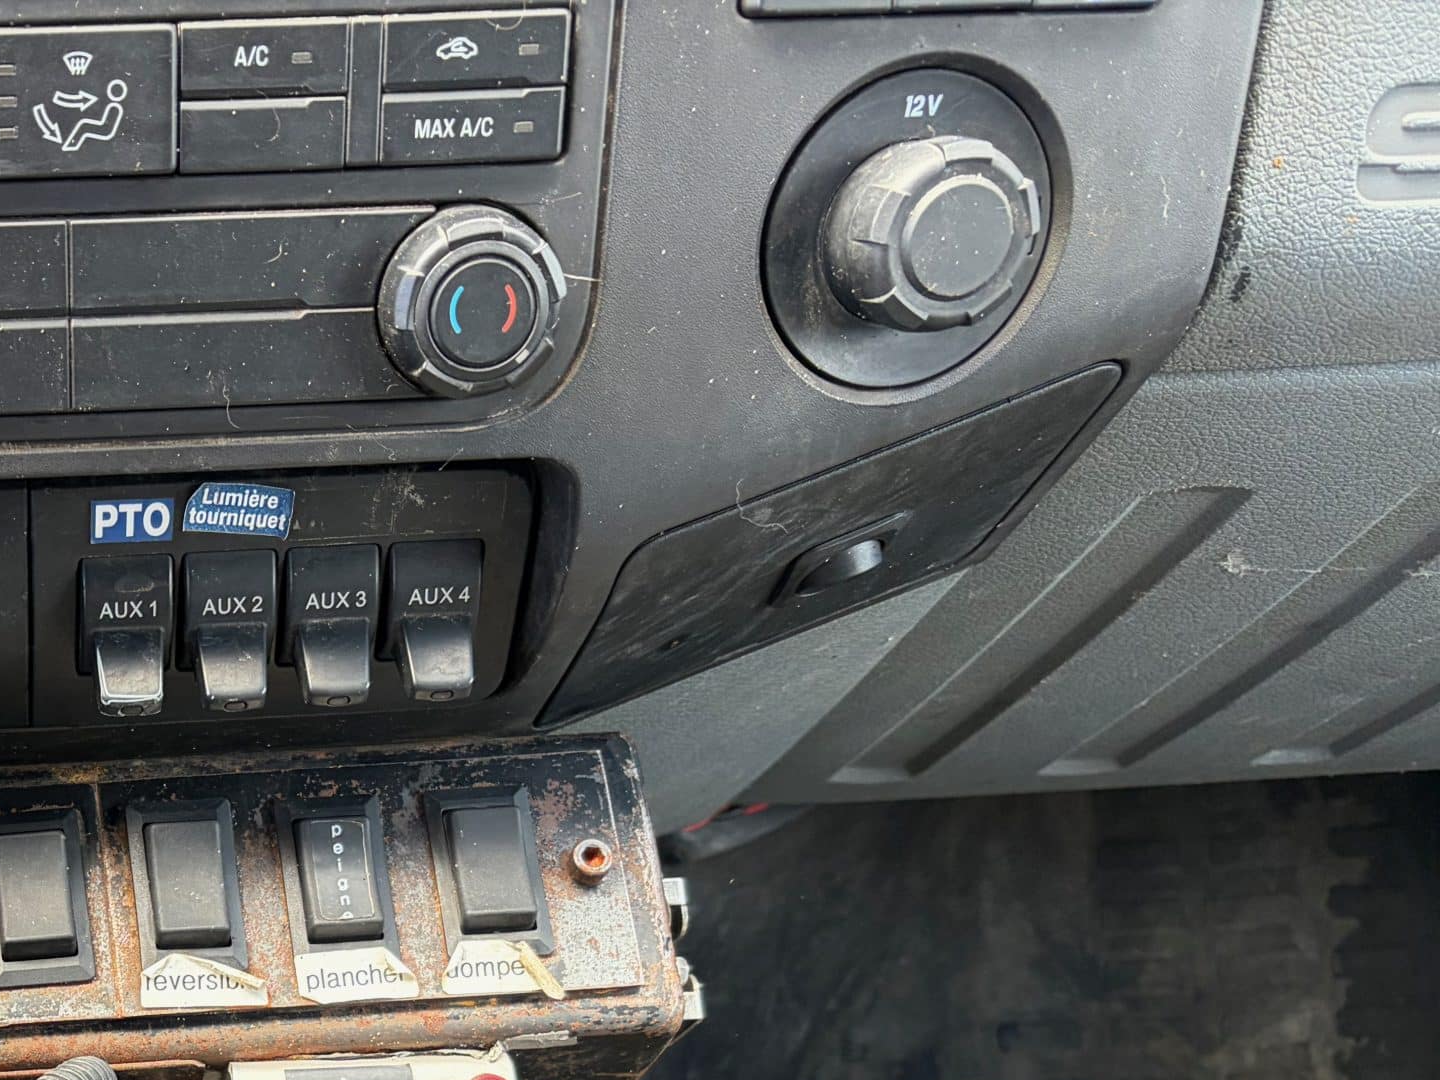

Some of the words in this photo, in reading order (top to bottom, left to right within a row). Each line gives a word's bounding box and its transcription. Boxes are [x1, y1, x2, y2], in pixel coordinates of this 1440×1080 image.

[234, 45, 269, 67] A/C
[904, 94, 944, 118] 12V
[414, 117, 456, 139] MAX
[460, 116, 494, 137] A/C
[202, 488, 279, 510] Lumière
[94, 502, 171, 539] PTO
[188, 508, 286, 531] tourniquet
[202, 597, 247, 616] AUX
[251, 596, 263, 612] 2
[305, 591, 351, 610] AUX
[355, 590, 367, 608] 3
[408, 586, 454, 606] AUX
[459, 586, 471, 603] 4
[99, 601, 143, 620] AUX
[149, 600, 158, 617] 1
